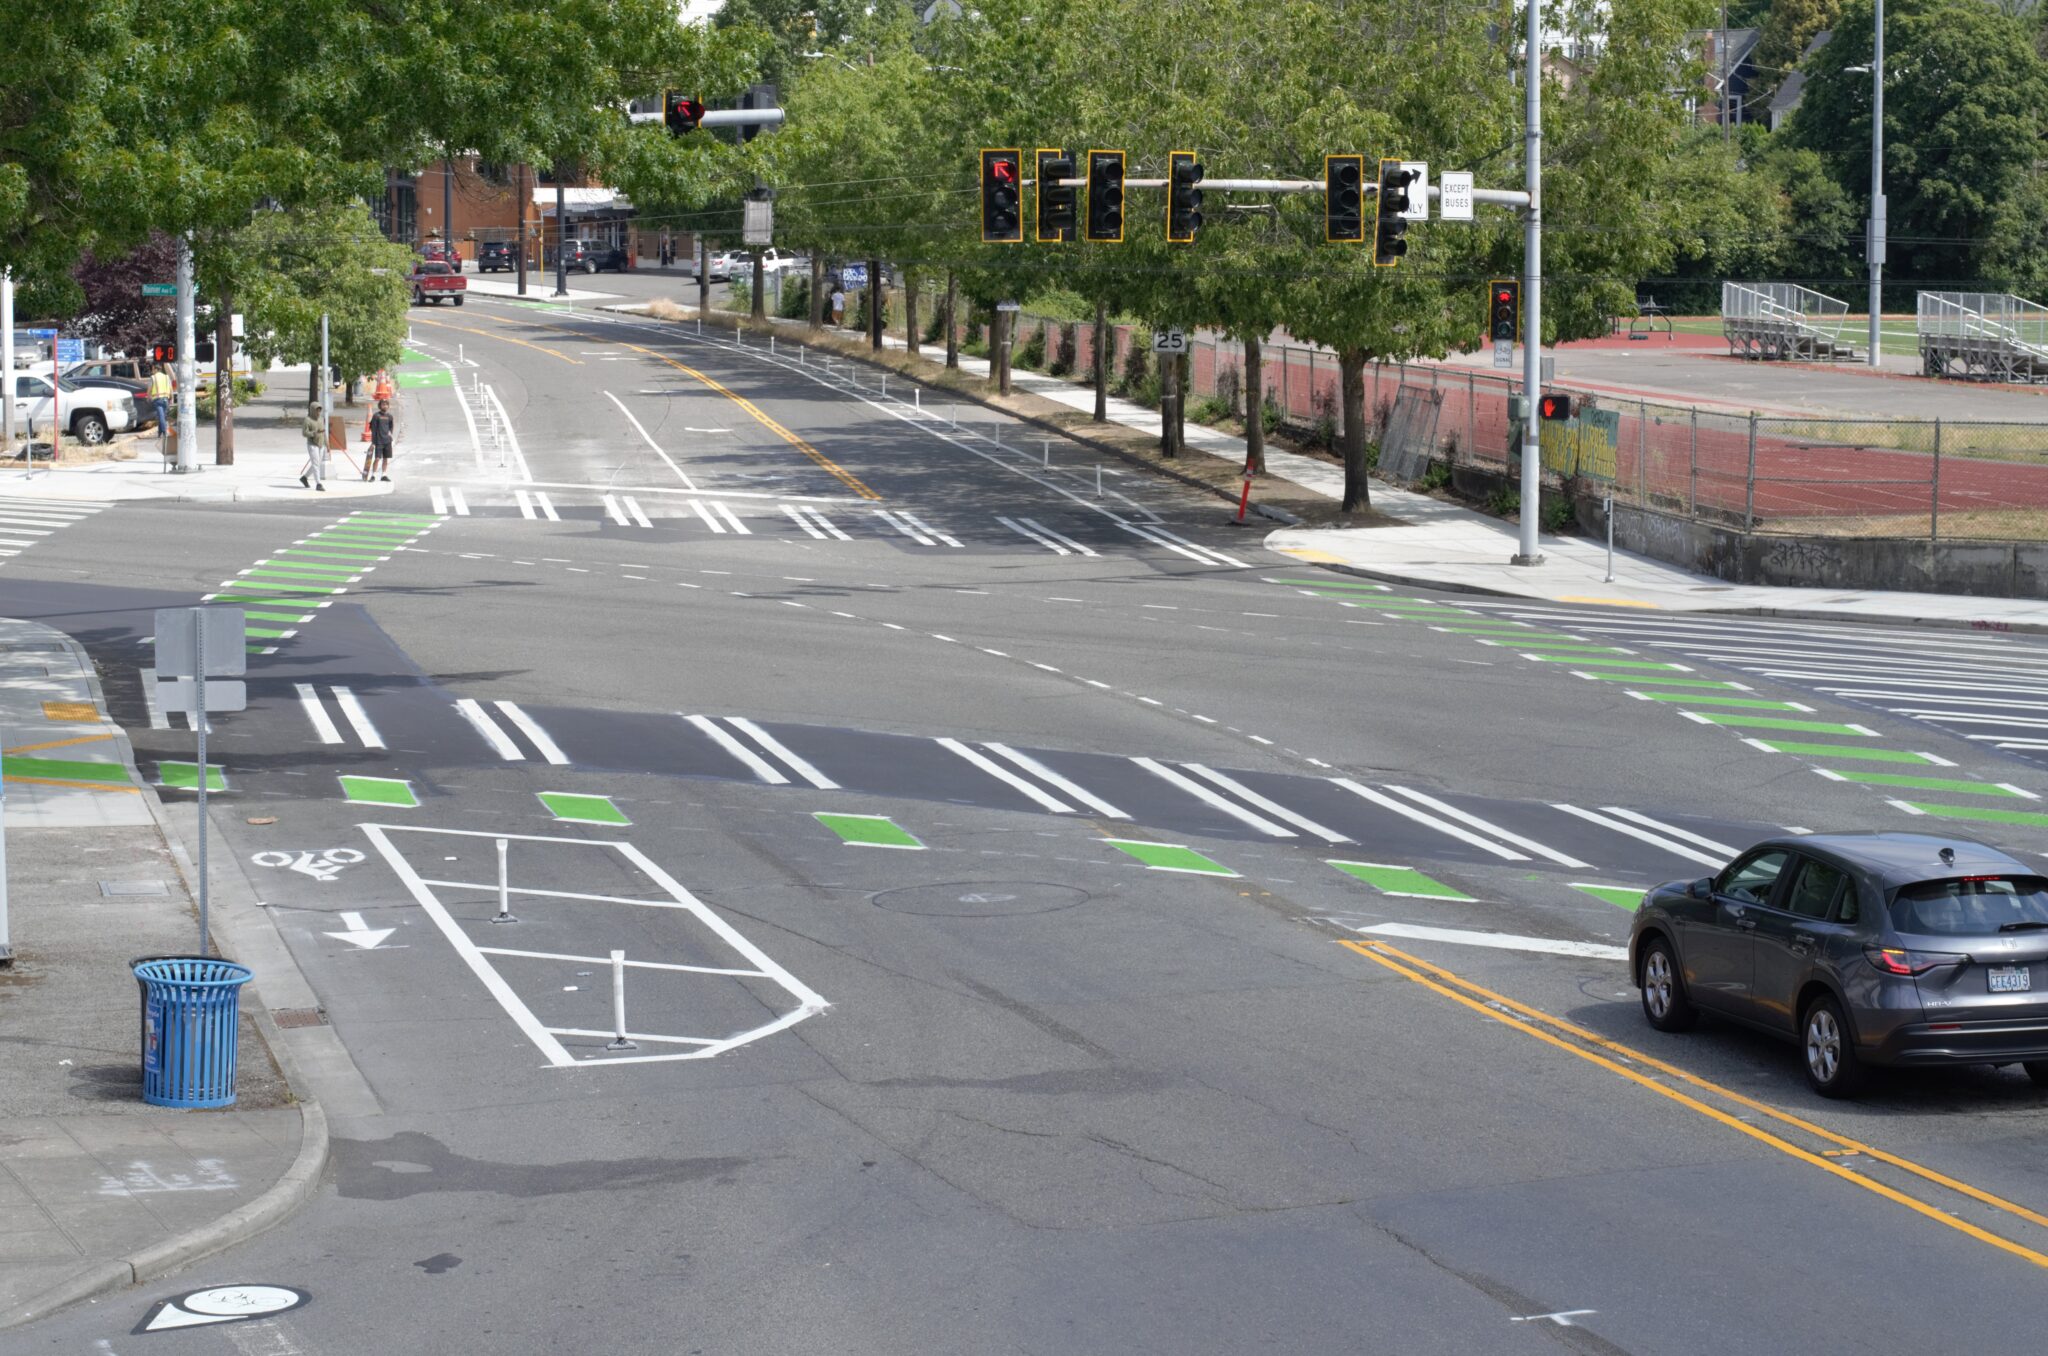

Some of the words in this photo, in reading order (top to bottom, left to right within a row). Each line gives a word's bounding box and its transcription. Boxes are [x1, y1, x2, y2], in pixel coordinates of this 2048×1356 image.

[1444, 184, 1469, 193] EXCEPT
[1408, 203, 1423, 214] NLY
[1445, 198, 1469, 208] BUSES
[1157, 333, 1182, 349] 25
[167, 346, 174, 360] 0
